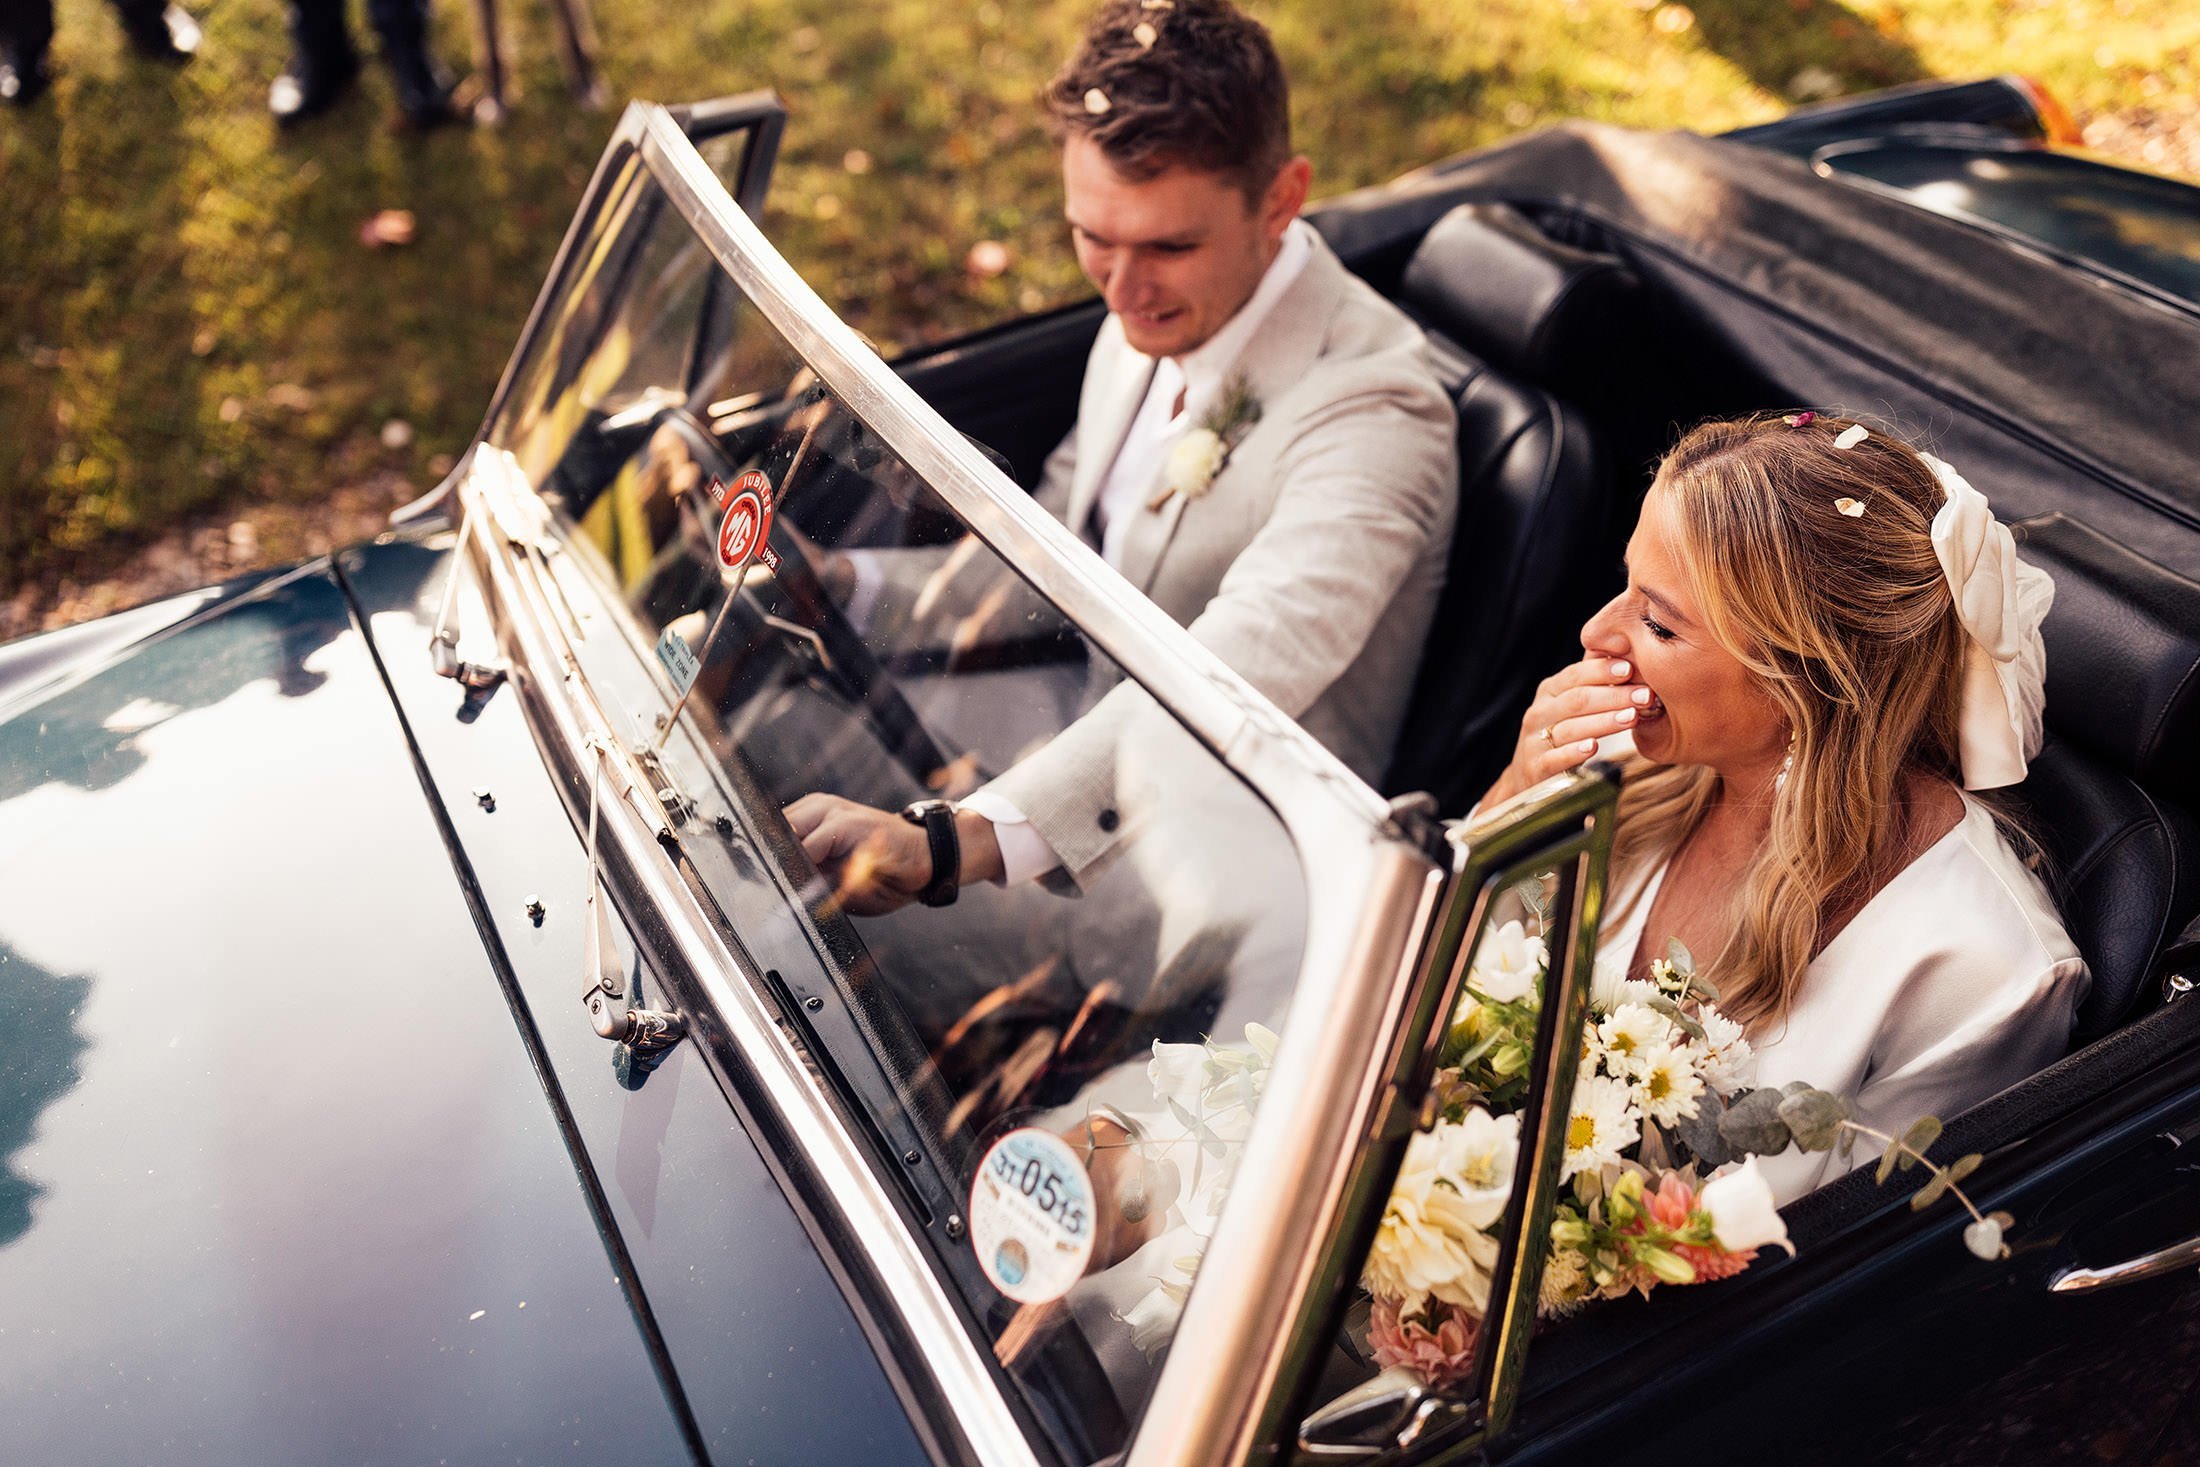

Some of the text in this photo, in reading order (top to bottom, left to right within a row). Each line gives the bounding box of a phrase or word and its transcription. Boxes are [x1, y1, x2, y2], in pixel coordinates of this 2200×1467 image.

[743, 475, 771, 516] JUBILEE
[726, 510, 751, 557] MG
[762, 547, 778, 569] 1998
[675, 658, 689, 680] ZONE
[1021, 1159, 1063, 1212] 05
